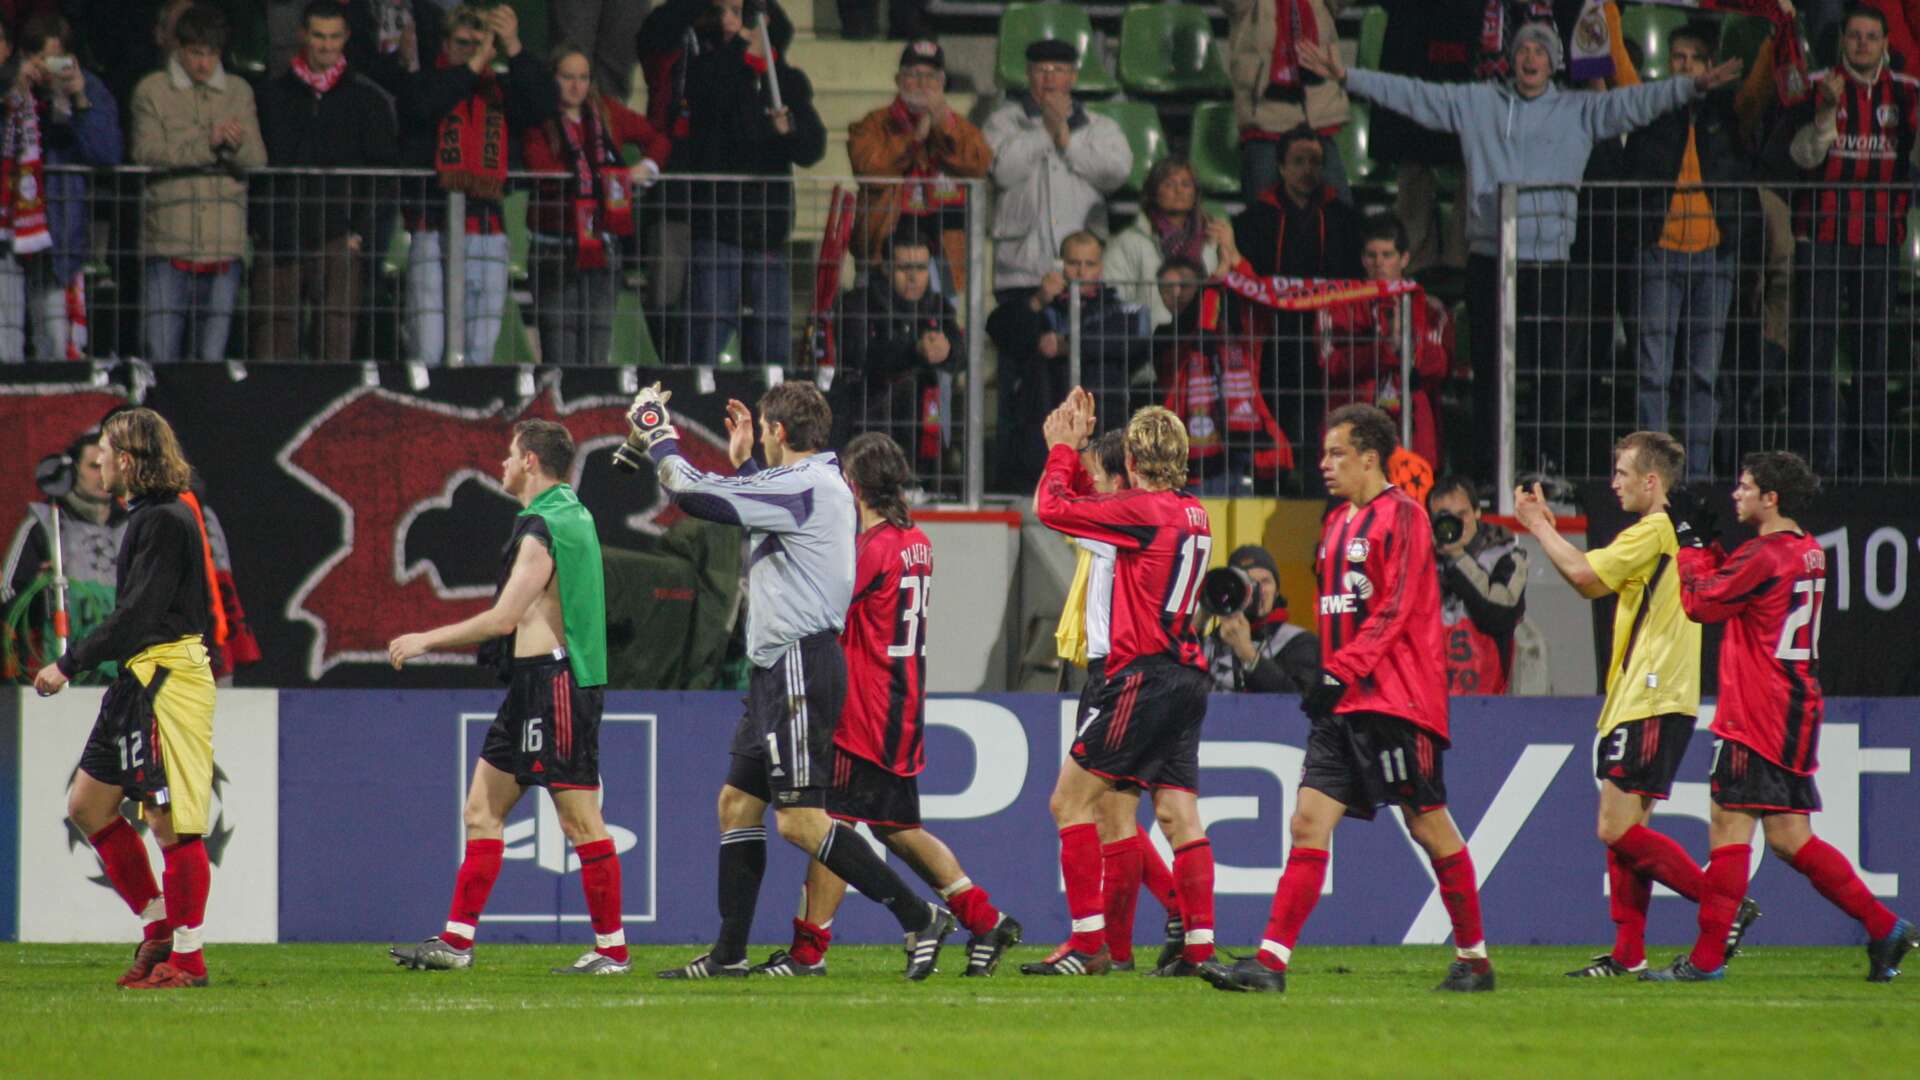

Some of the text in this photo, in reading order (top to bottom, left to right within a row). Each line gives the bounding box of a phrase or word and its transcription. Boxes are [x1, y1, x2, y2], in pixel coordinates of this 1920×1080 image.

[1166, 534, 1212, 614] 17
[1816, 526, 1920, 611] 10
[1321, 594, 1357, 615] RWE
[1775, 578, 1826, 661] 27
[118, 730, 144, 770] 12
[522, 718, 543, 752] 16
[766, 732, 781, 765] 1
[1379, 747, 1408, 783] 11
